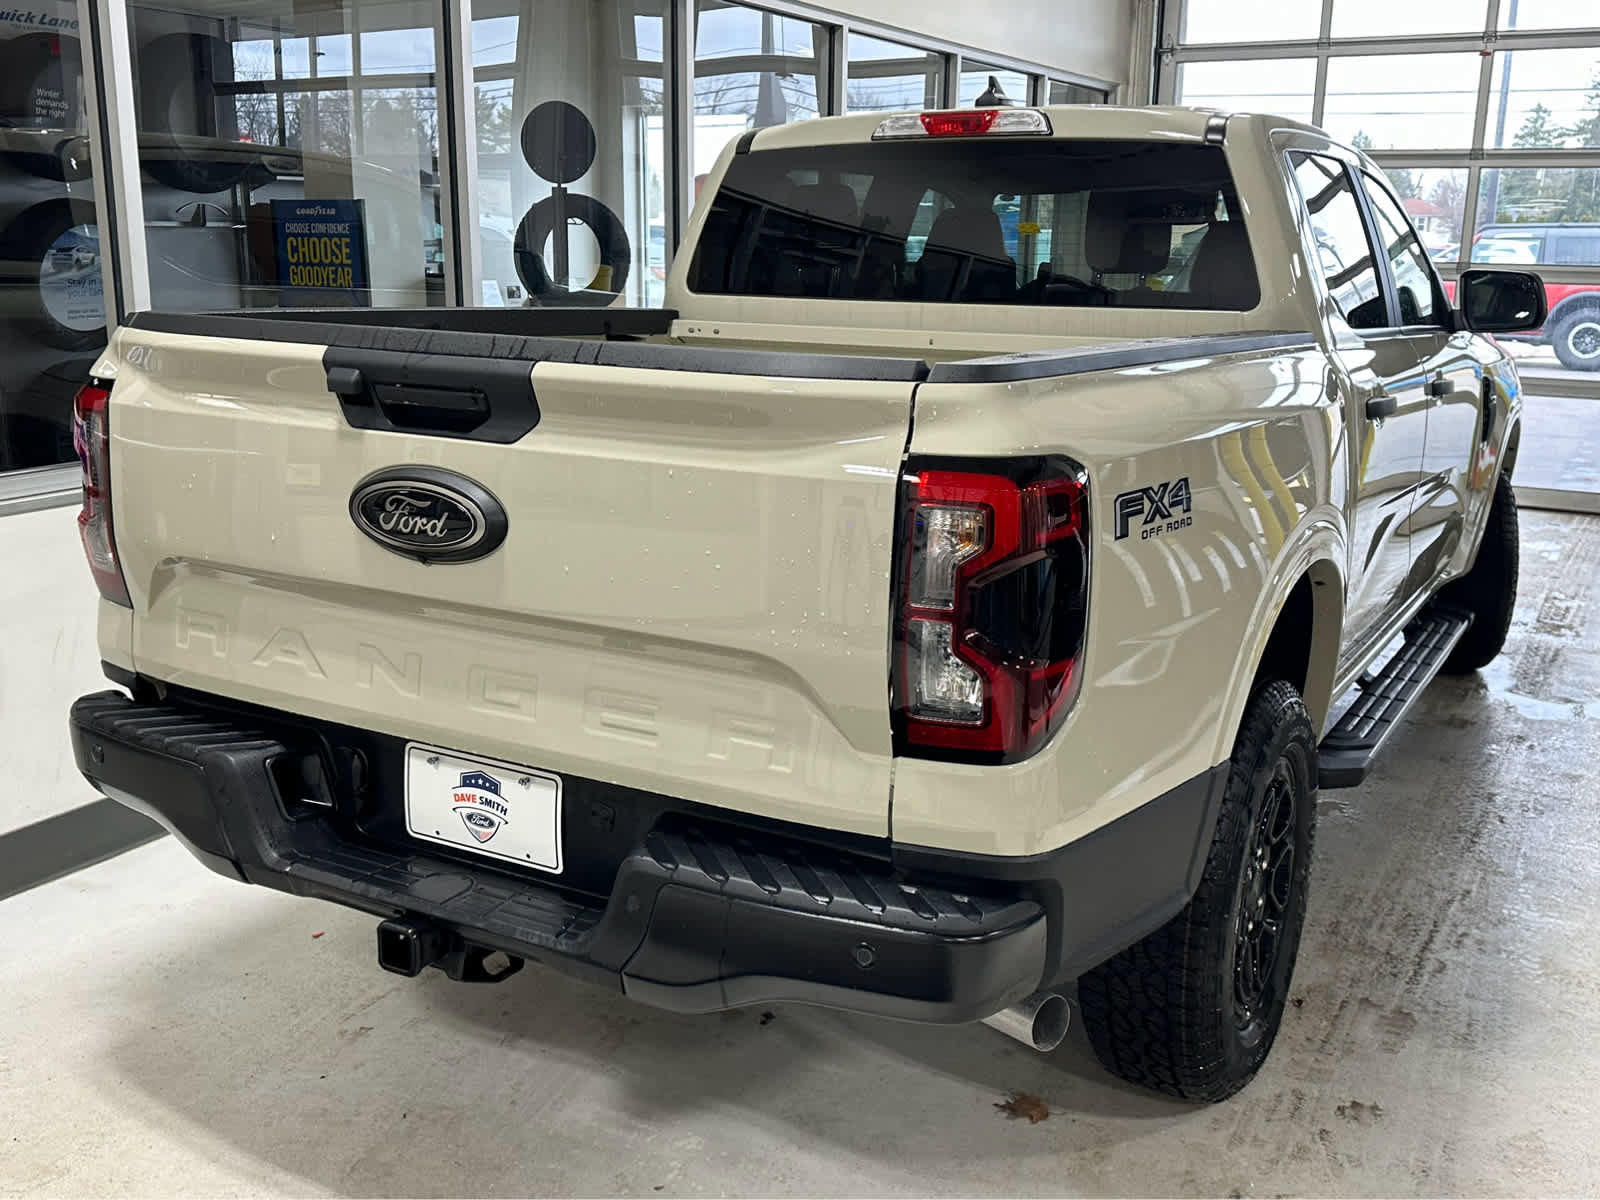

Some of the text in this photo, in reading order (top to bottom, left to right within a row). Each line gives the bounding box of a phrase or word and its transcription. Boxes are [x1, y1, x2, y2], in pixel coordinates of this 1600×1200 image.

[0, 9, 36, 24] uick
[39, 13, 79, 30] Lane
[285, 223, 350, 234] CHOOSE CONFIDENCE
[287, 237, 352, 264] CHOOSE
[289, 265, 353, 288] GOODYEAR
[379, 494, 449, 537] Ford
[1114, 477, 1191, 541] FX4
[1141, 516, 1193, 540] OFF ROAD
[175, 606, 793, 774] RANGER
[453, 793, 508, 816] DAVE SMITH
[471, 814, 490, 827] Ford
